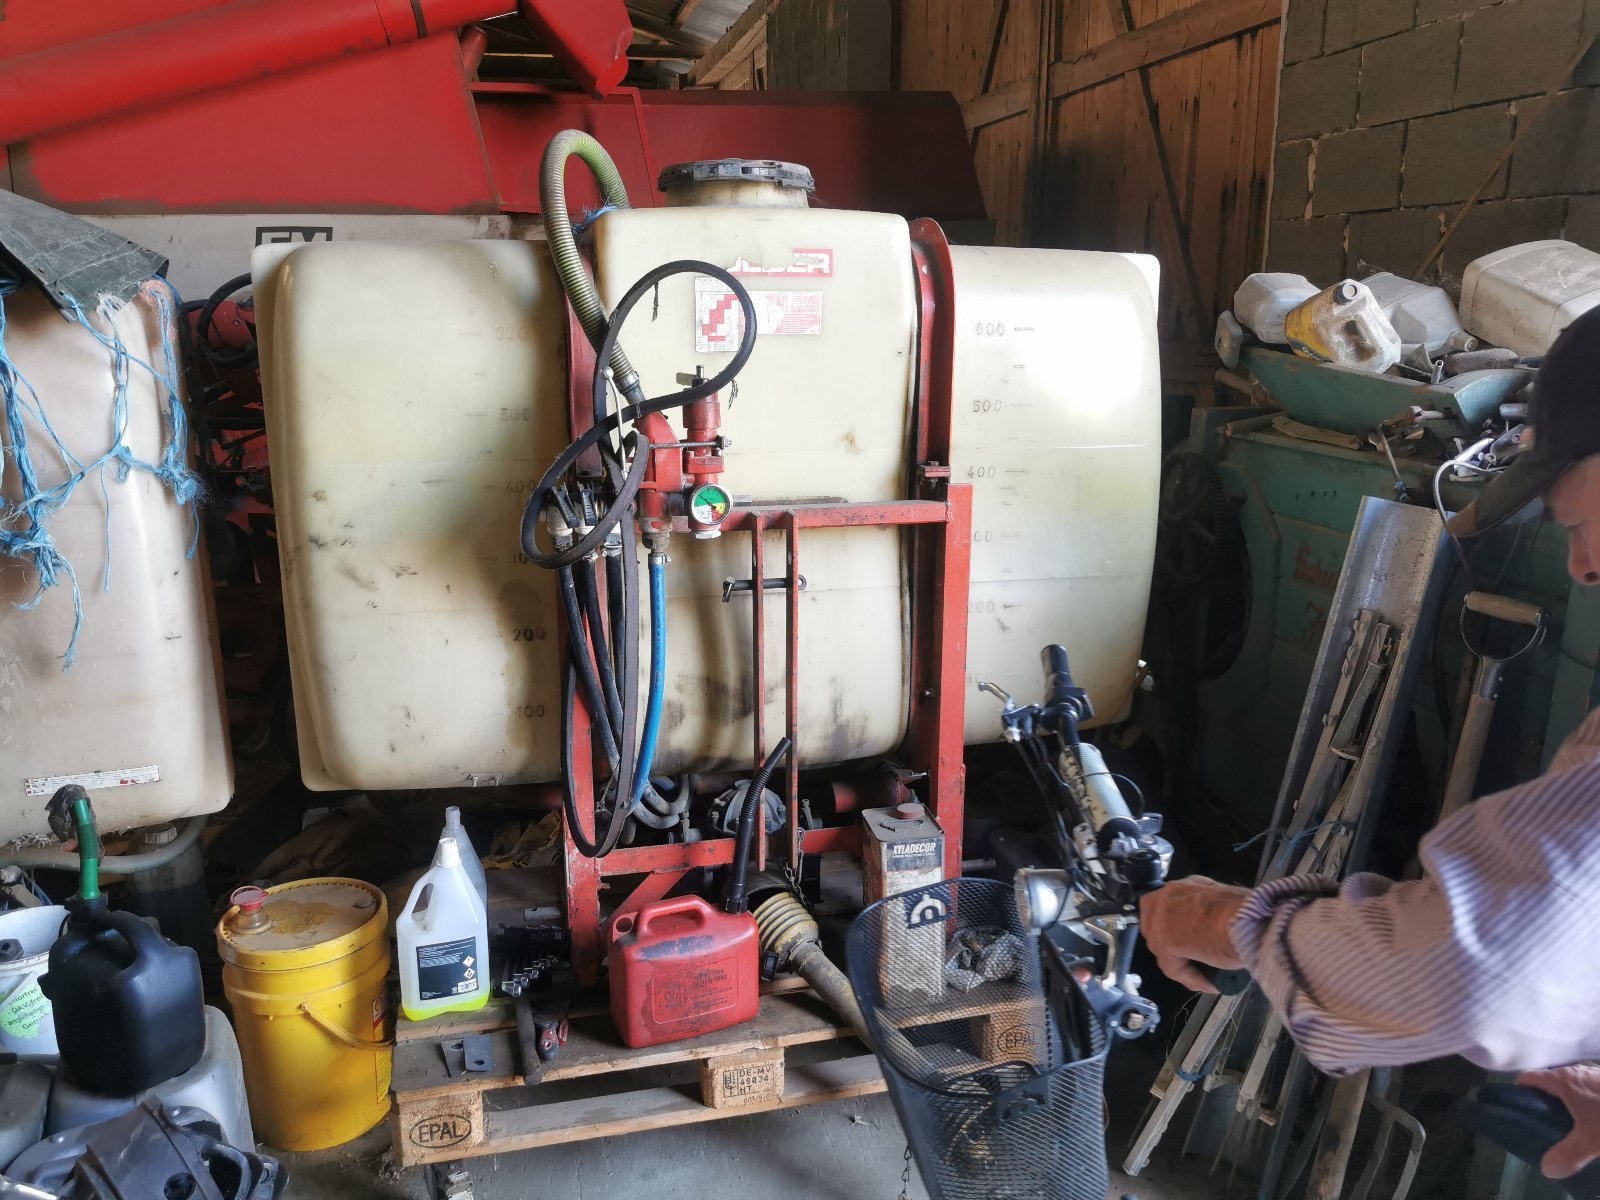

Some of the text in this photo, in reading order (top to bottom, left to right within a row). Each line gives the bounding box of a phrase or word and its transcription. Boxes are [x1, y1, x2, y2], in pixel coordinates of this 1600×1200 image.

[976, 322, 1005, 337] 600
[973, 399, 1002, 413] 500
[967, 465, 997, 479] 400
[973, 530, 993, 543] 00
[512, 626, 546, 642] 200
[893, 842, 937, 855] XYLADECOR
[740, 1085, 753, 1095] HT
[418, 1120, 464, 1143] EPAL
